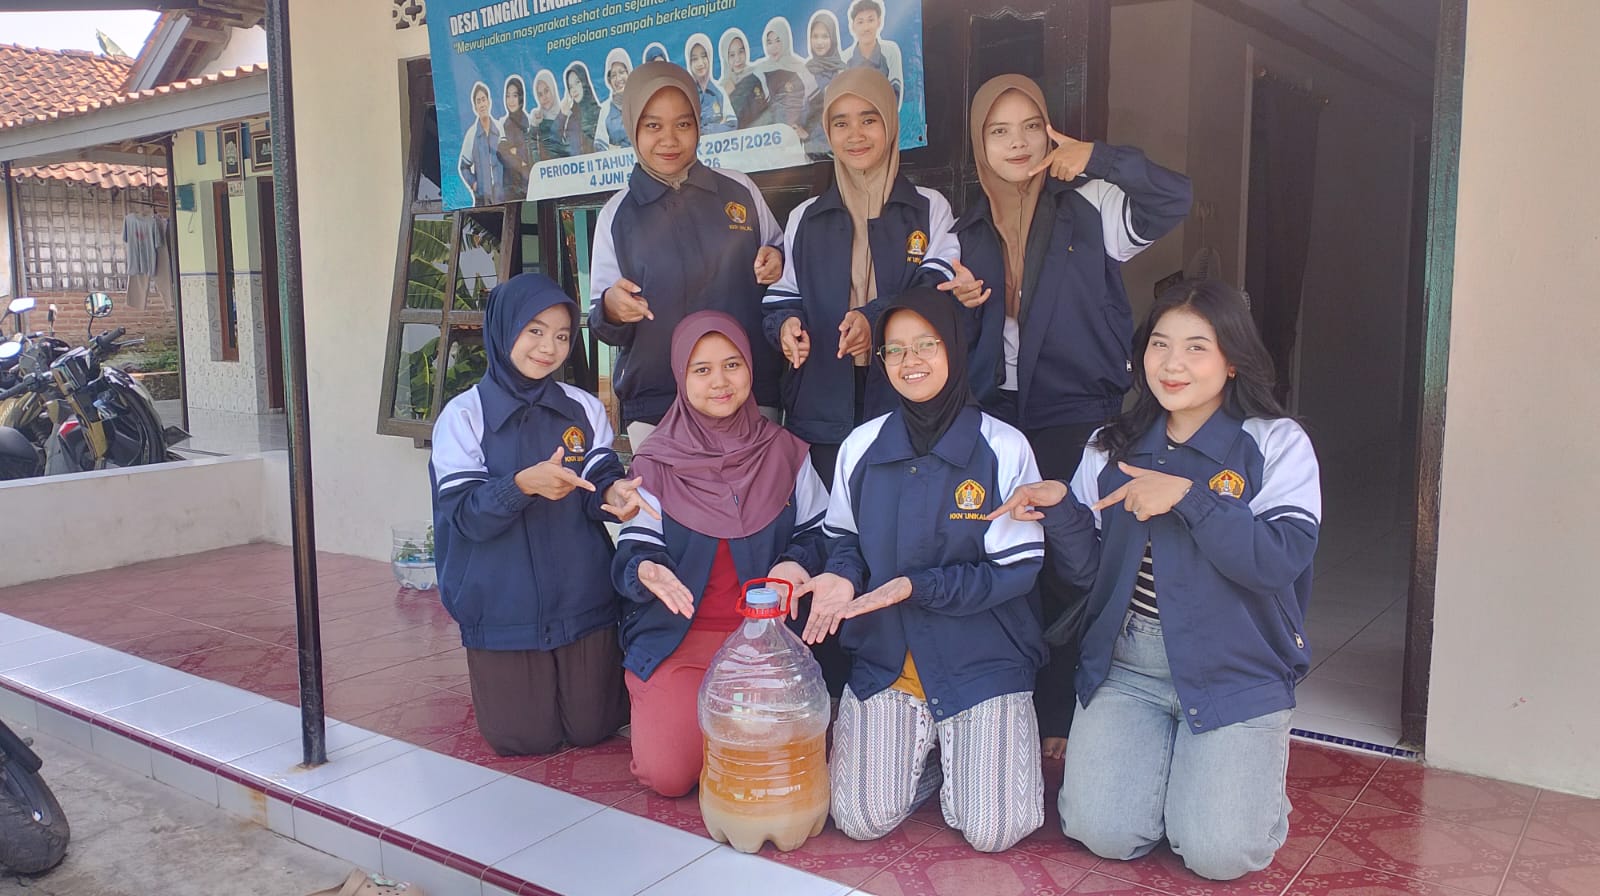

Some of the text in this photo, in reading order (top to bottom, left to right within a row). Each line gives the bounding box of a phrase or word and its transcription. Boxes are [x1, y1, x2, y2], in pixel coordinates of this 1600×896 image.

[449, 10, 480, 36] DESA
[480, 0, 530, 28] TANGKIL
[513, 16, 569, 38] masyarakat
[571, 9, 600, 25] sehat
[602, 4, 622, 17] dan
[547, 0, 736, 54] pengelolaan sampah berkelanjutan
[540, 161, 585, 179] PERIODE
[587, 161, 594, 173] II
[595, 154, 635, 170] TAHUN
[705, 131, 782, 155] 2025/2026
[590, 174, 597, 187] 4
[599, 172, 624, 186] JUNI
[704, 158, 721, 169] 26
[949, 512, 963, 520] KKN
